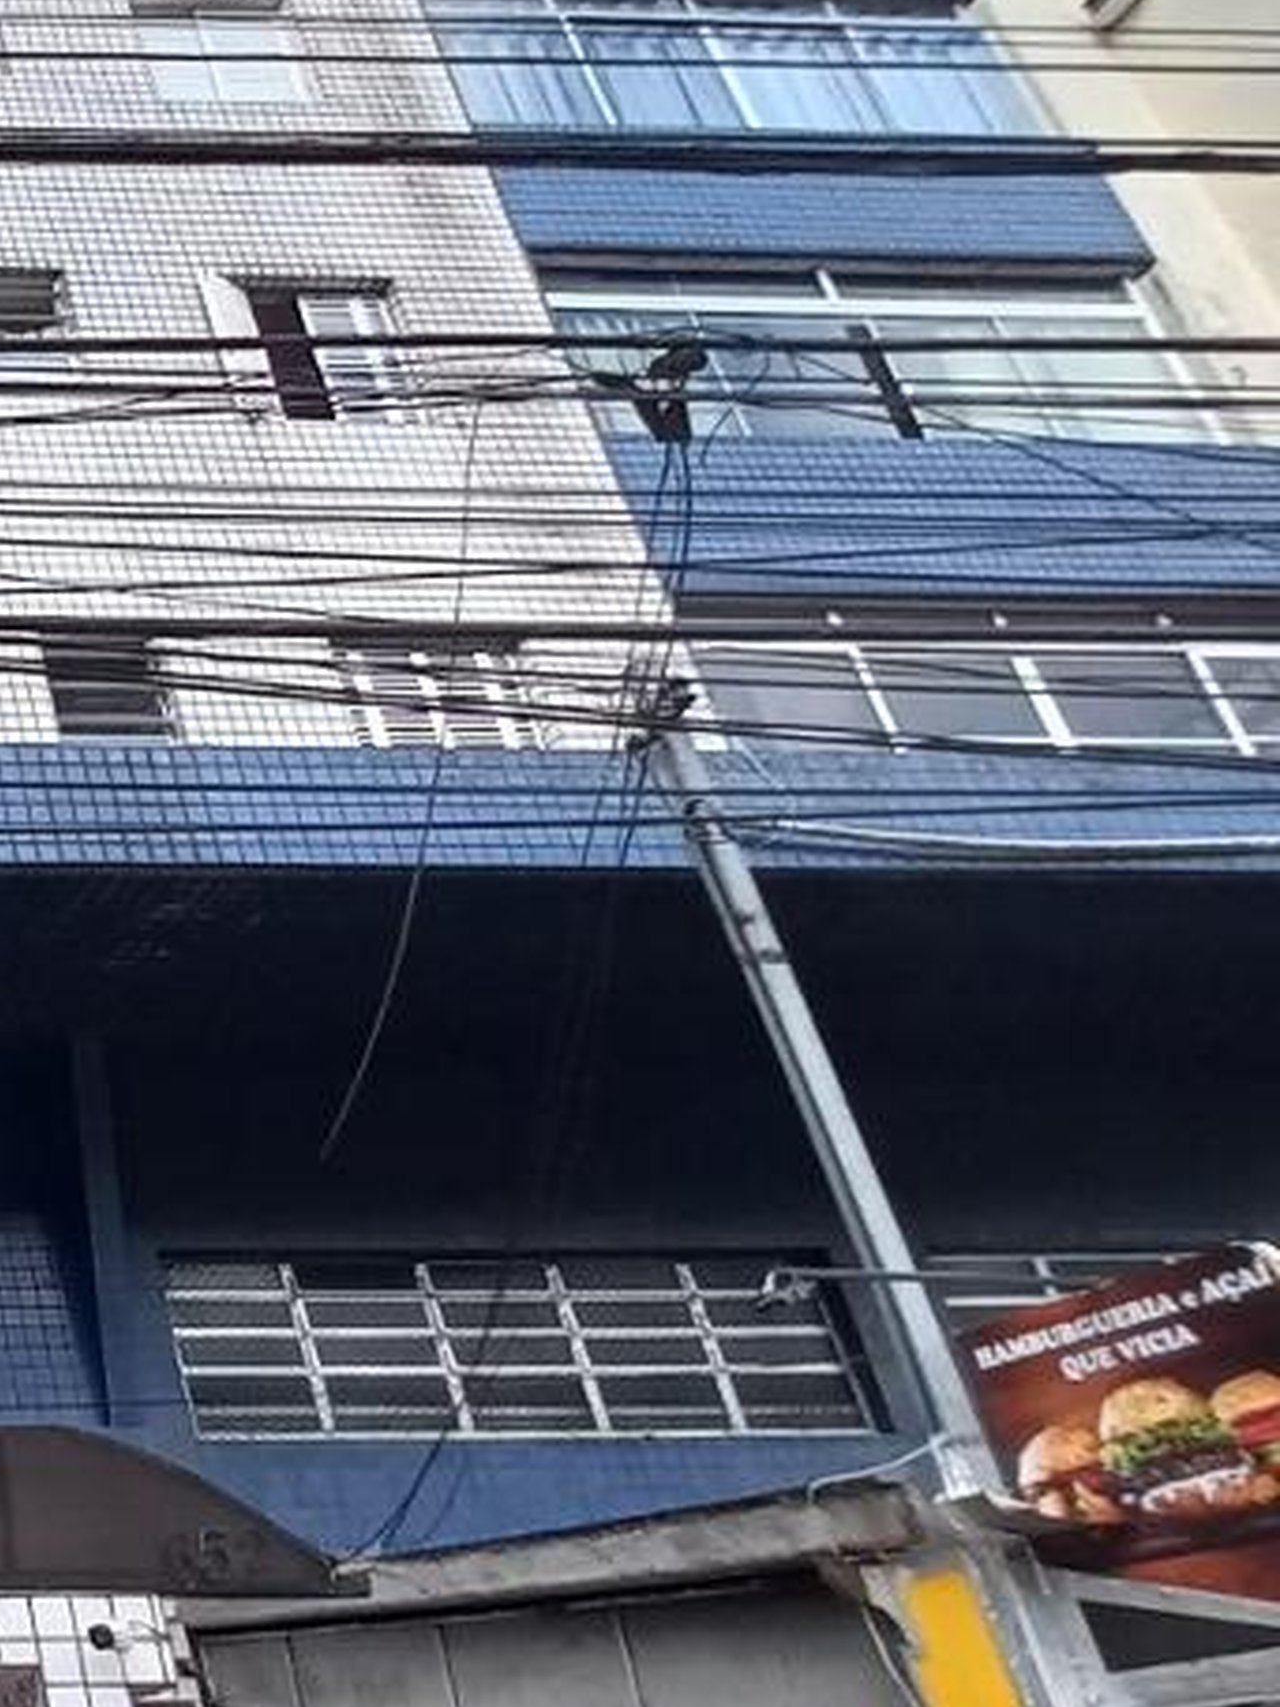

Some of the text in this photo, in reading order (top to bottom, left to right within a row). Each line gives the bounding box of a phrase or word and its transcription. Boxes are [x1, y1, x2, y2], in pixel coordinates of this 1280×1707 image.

[974, 1292, 1180, 1371] HAMBURGUERIA
[1059, 1323, 1200, 1382] QUE VICIA
